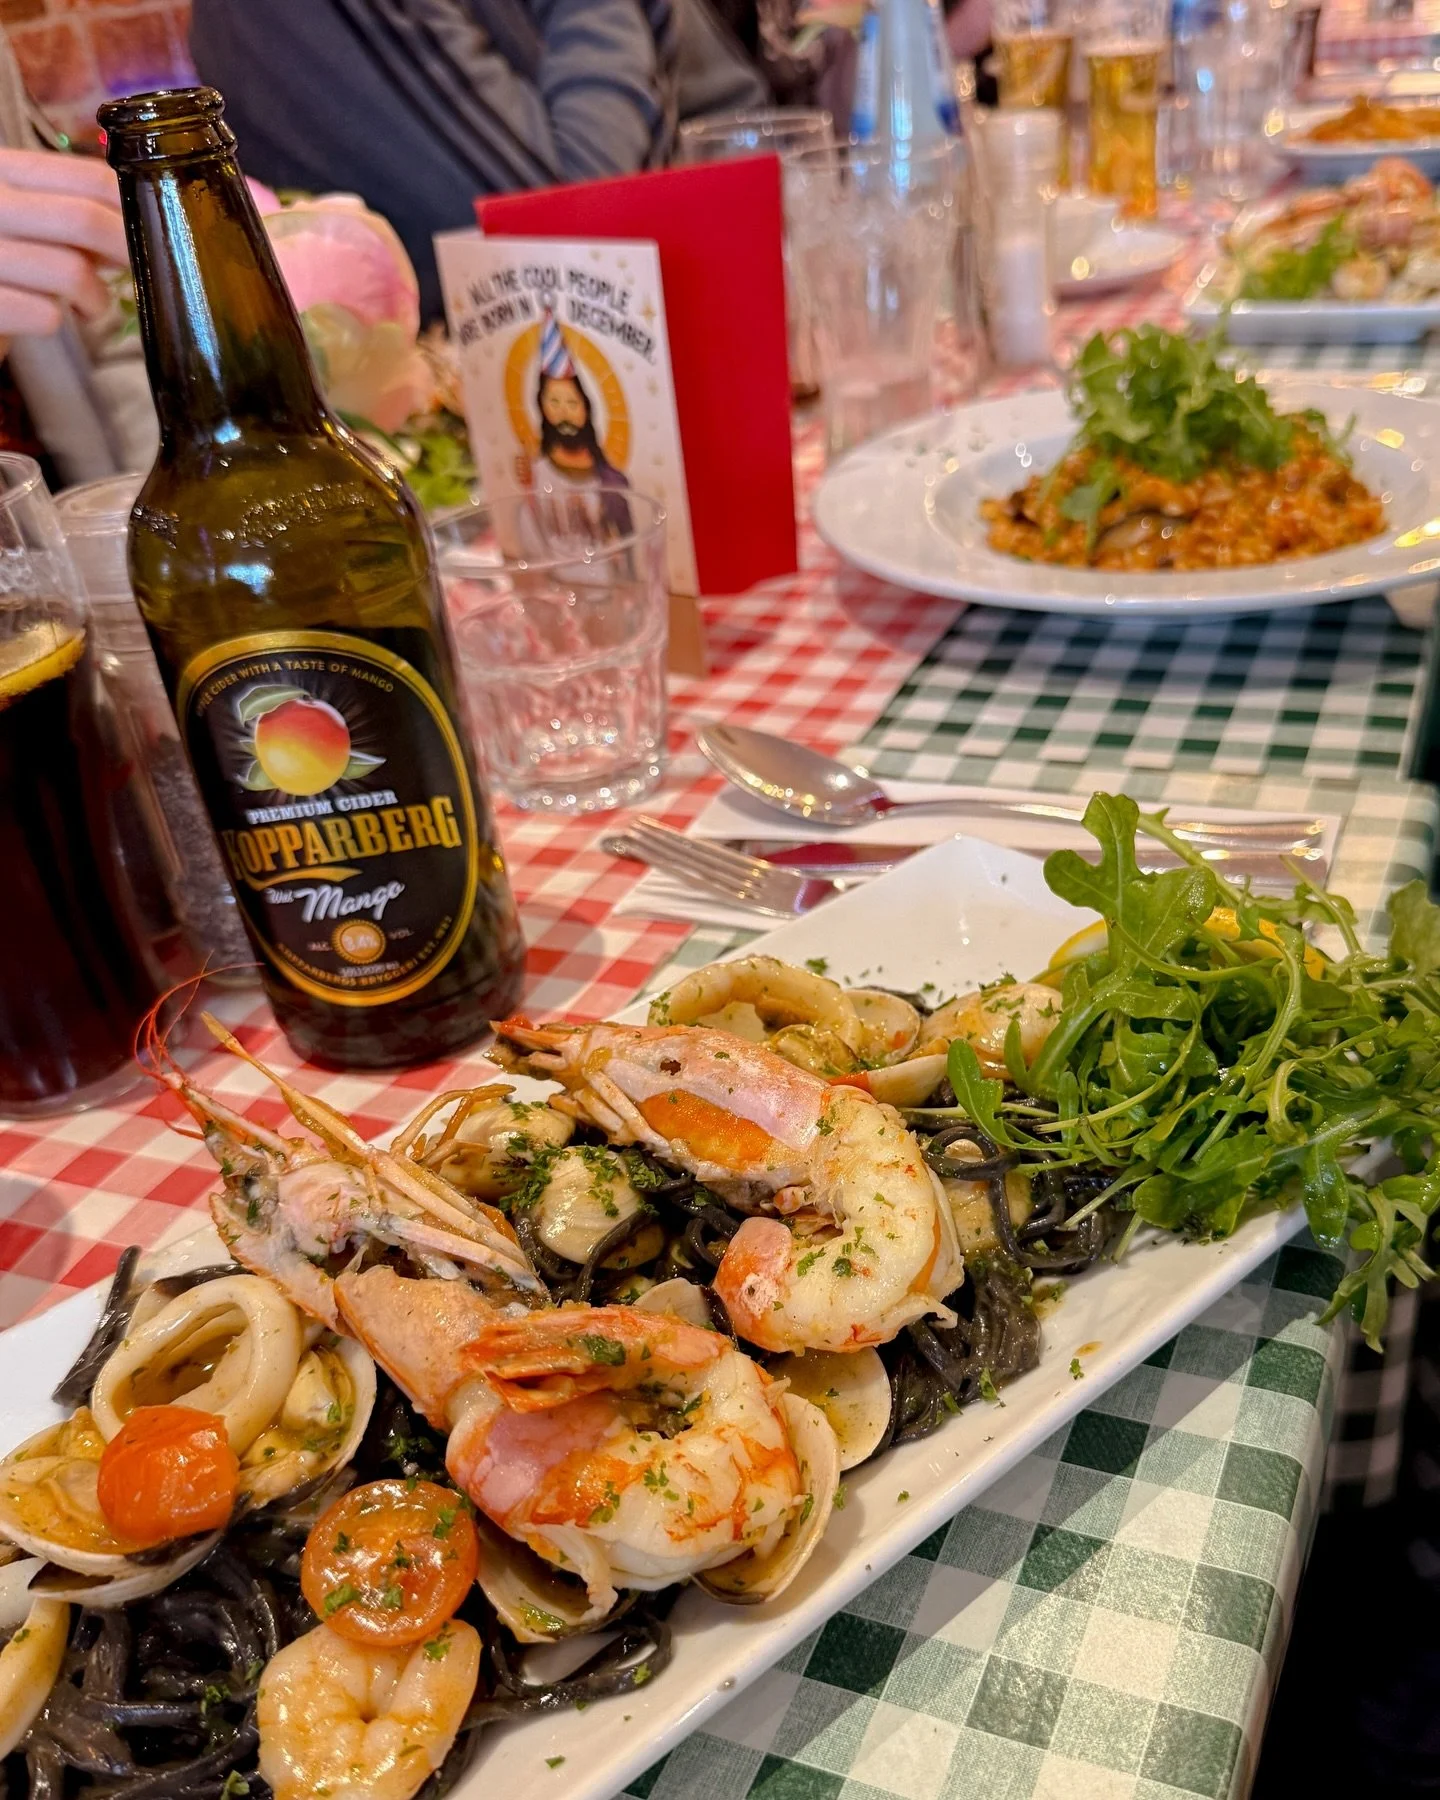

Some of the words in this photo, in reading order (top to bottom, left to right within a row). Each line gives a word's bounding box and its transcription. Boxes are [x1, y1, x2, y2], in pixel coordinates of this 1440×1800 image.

[467, 279, 497, 307] ALL
[490, 267, 522, 295] THE
[521, 265, 564, 291] COOL
[567, 269, 630, 314] PEOPLE
[480, 301, 516, 334] BORN
[211, 673, 240, 696] CIDER
[239, 662, 271, 679] WITH
[273, 661, 282, 672] A
[286, 660, 325, 671] TASTE
[330, 661, 348, 673] OF
[351, 668, 395, 693] MANGO
[246, 801, 333, 824] PREMIUM
[336, 790, 398, 811] CIDER
[222, 796, 462, 881] KOPPARBERG
[293, 880, 405, 923] Mango
